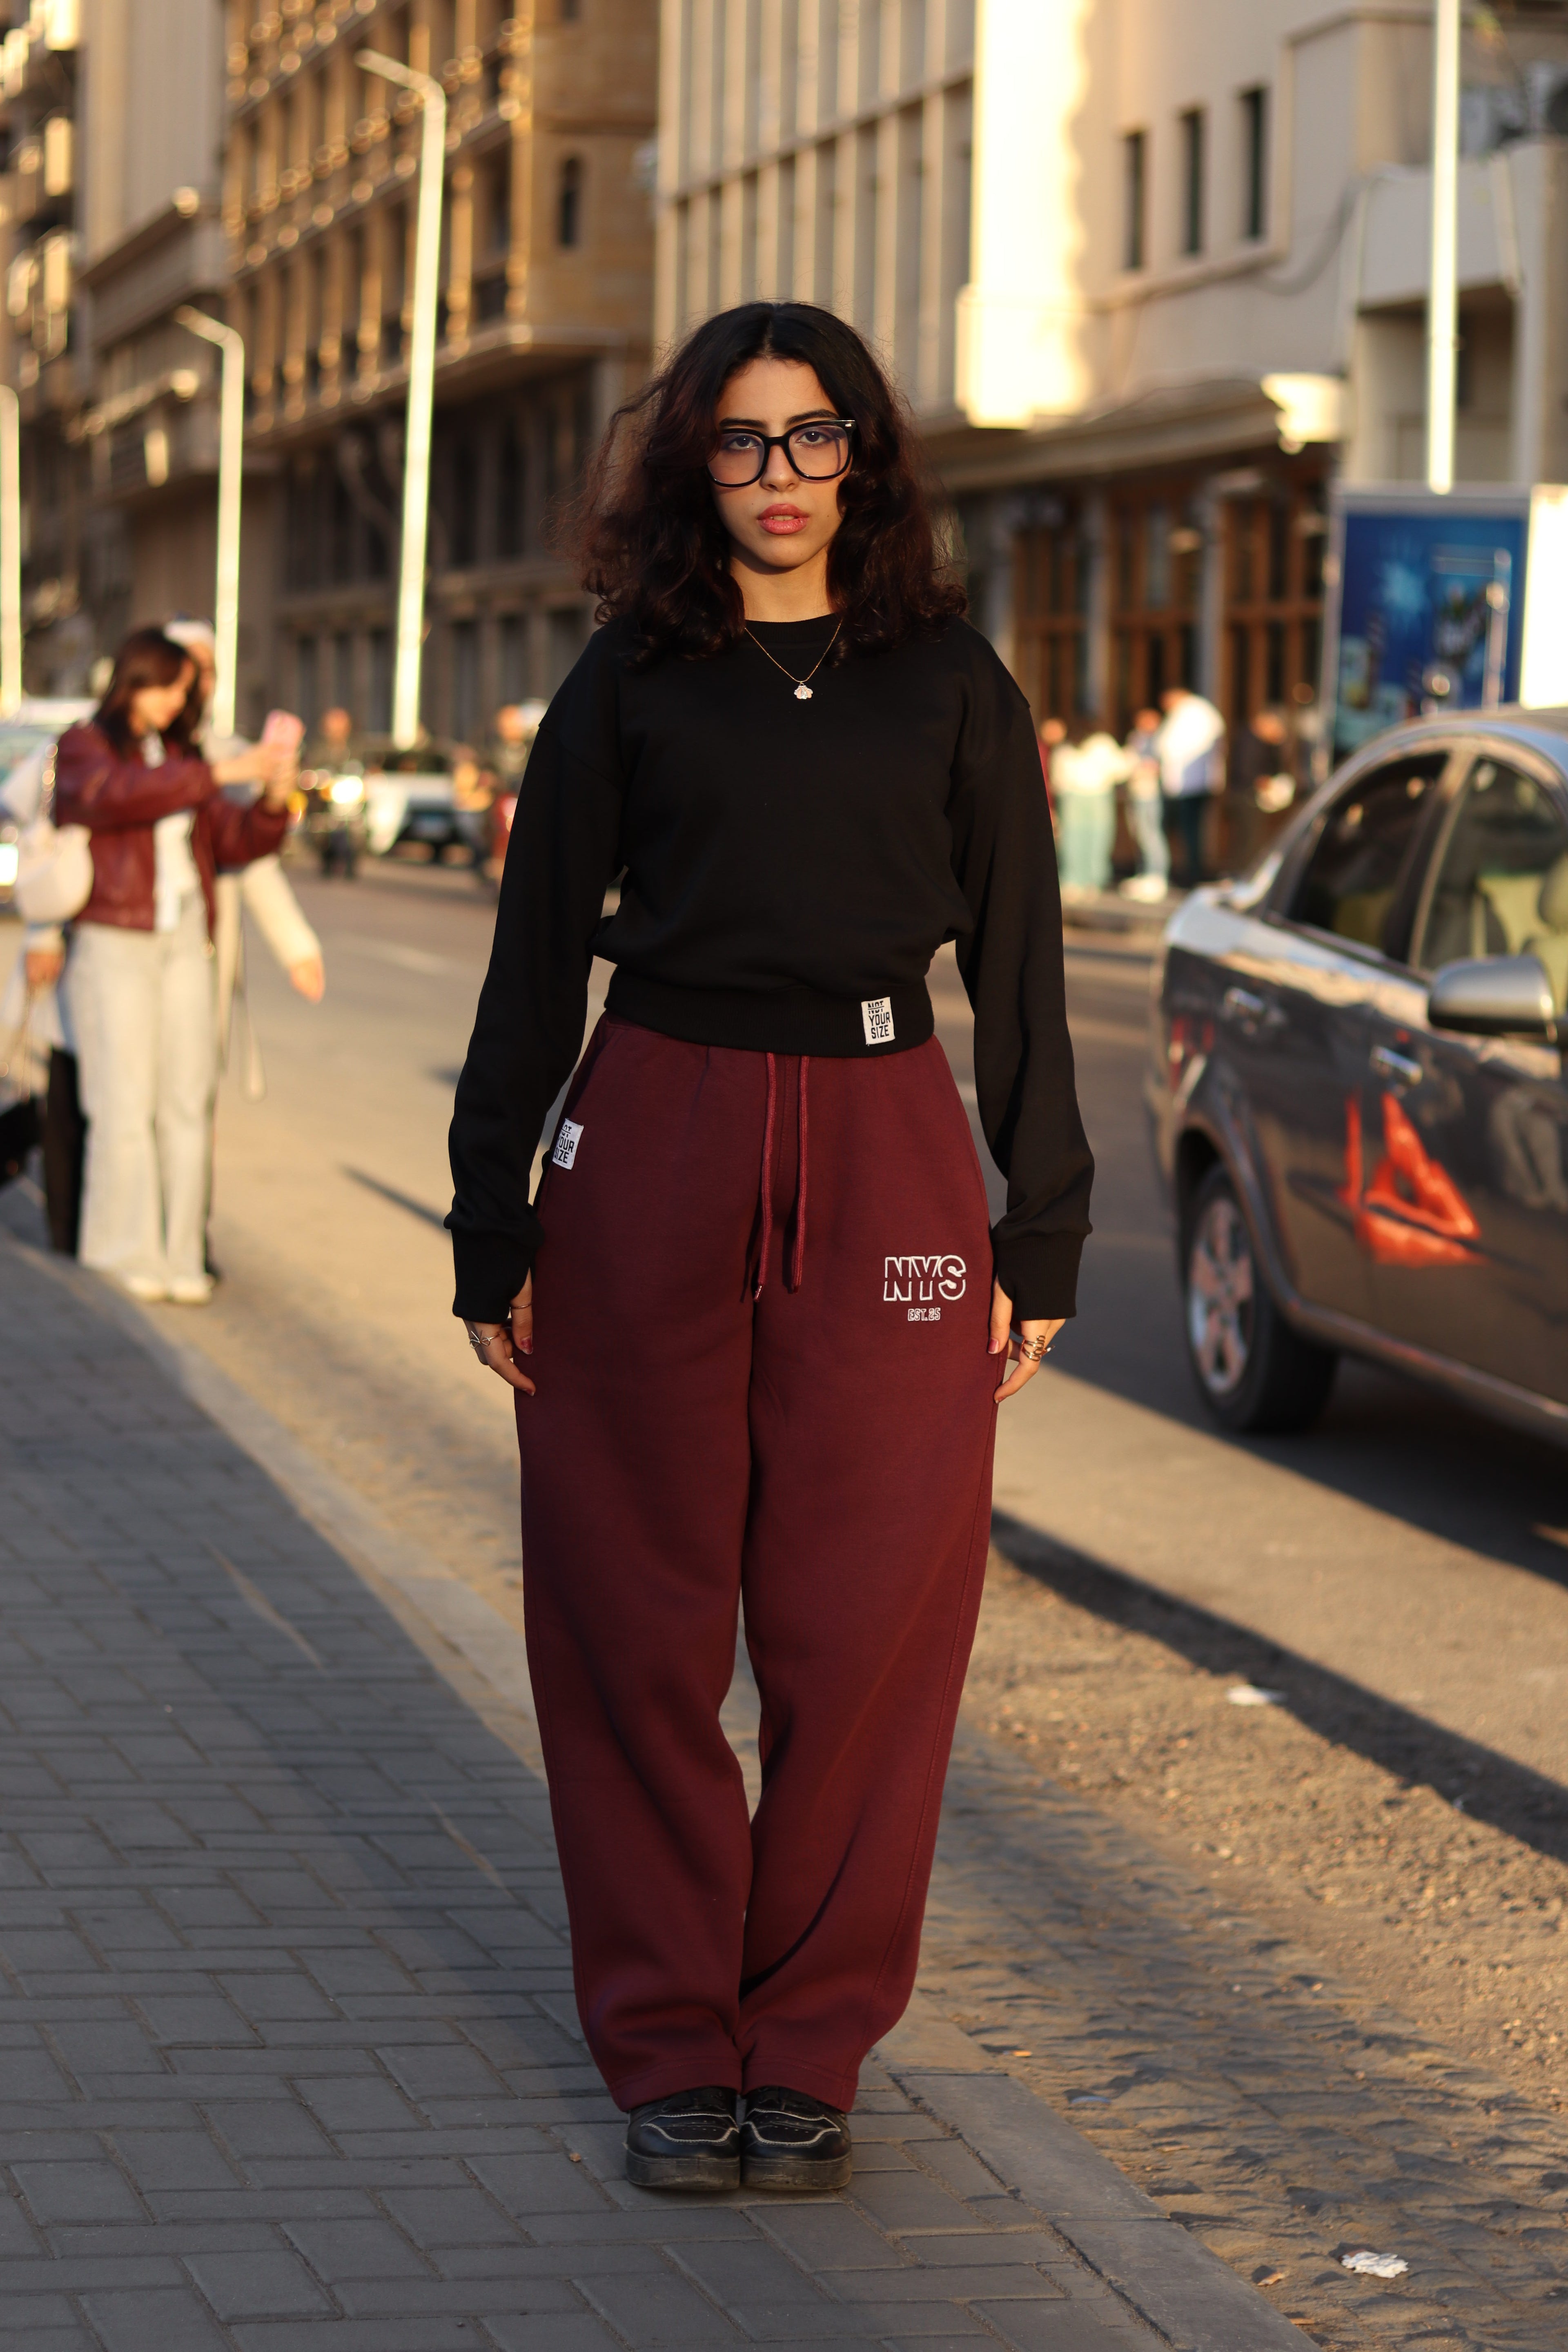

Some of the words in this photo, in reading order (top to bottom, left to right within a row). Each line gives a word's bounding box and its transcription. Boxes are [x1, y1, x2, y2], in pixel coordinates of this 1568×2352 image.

[868, 1000, 884, 1014] NOT
[869, 1012, 891, 1026] YOUR
[871, 1025, 889, 1039] SIZE
[561, 1124, 572, 1138] OT
[554, 1147, 569, 1164] SIZE
[884, 1255, 967, 1301] NYS
